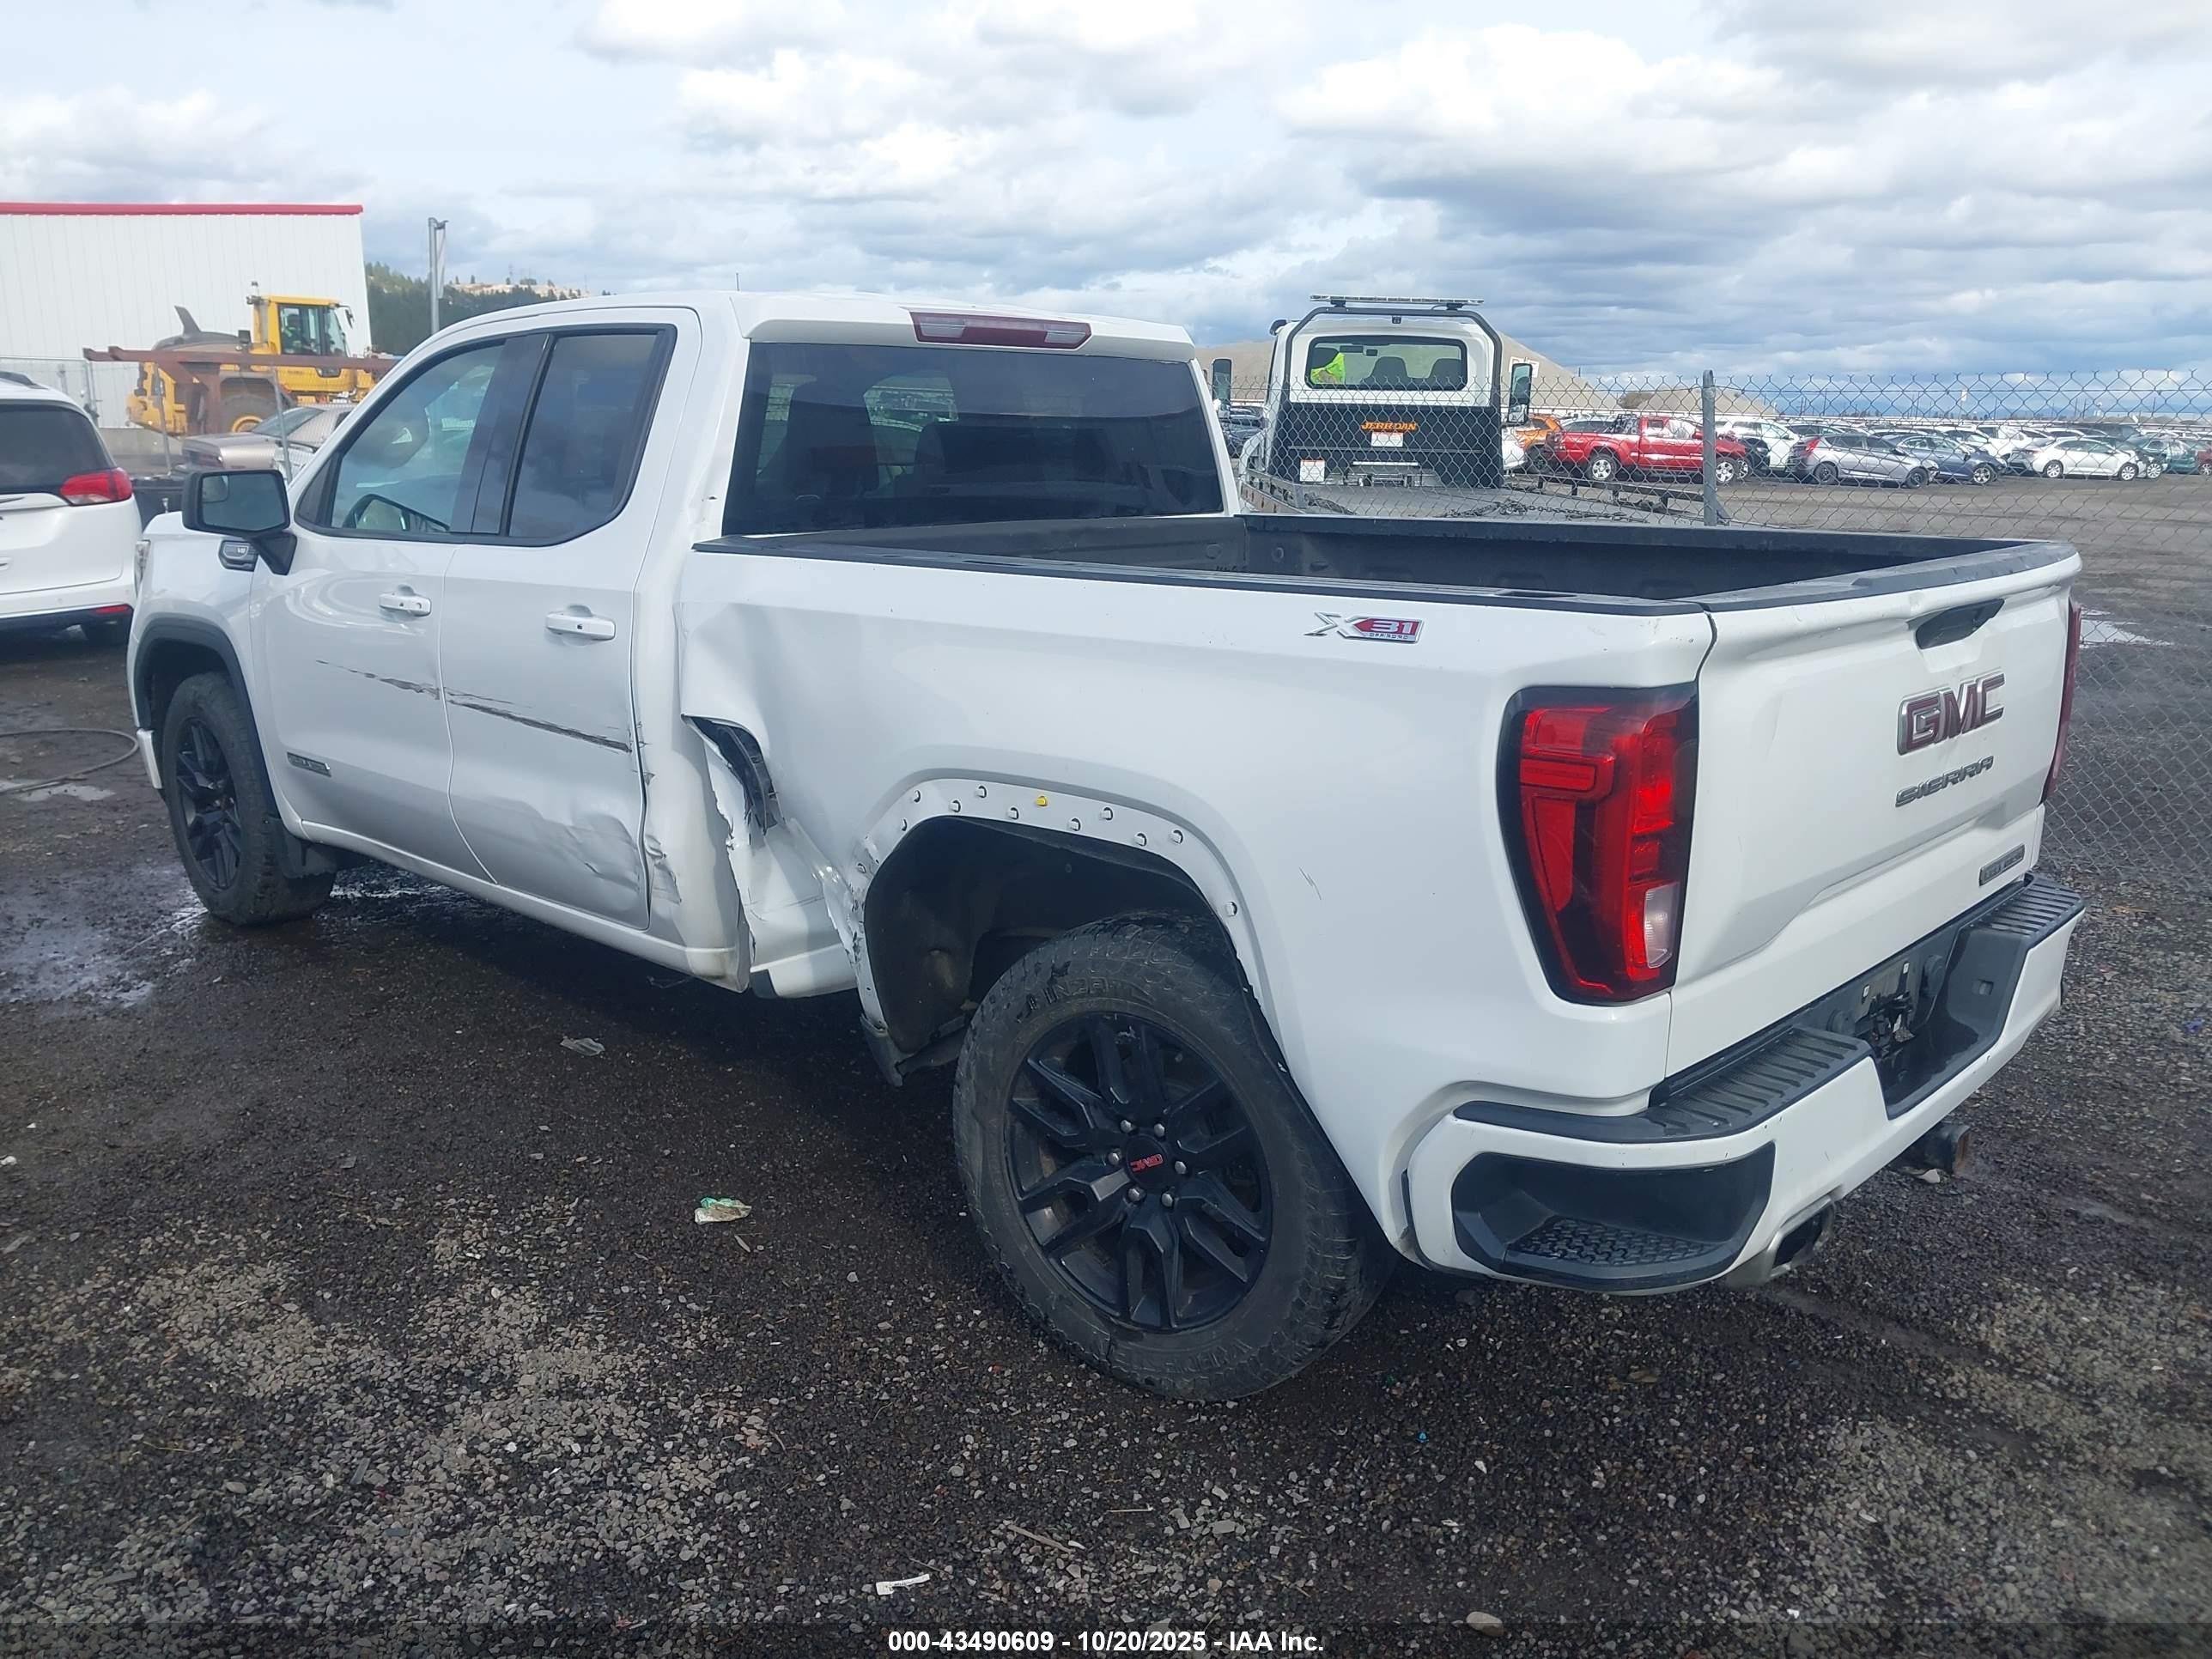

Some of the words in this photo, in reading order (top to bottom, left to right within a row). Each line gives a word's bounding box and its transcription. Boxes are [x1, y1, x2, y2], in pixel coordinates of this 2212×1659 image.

[1304, 612, 1417, 641] X31
[1897, 669, 2005, 756] GMC
[1895, 755, 1995, 807] SIERRA
[1130, 1153, 1164, 1172] GMC
